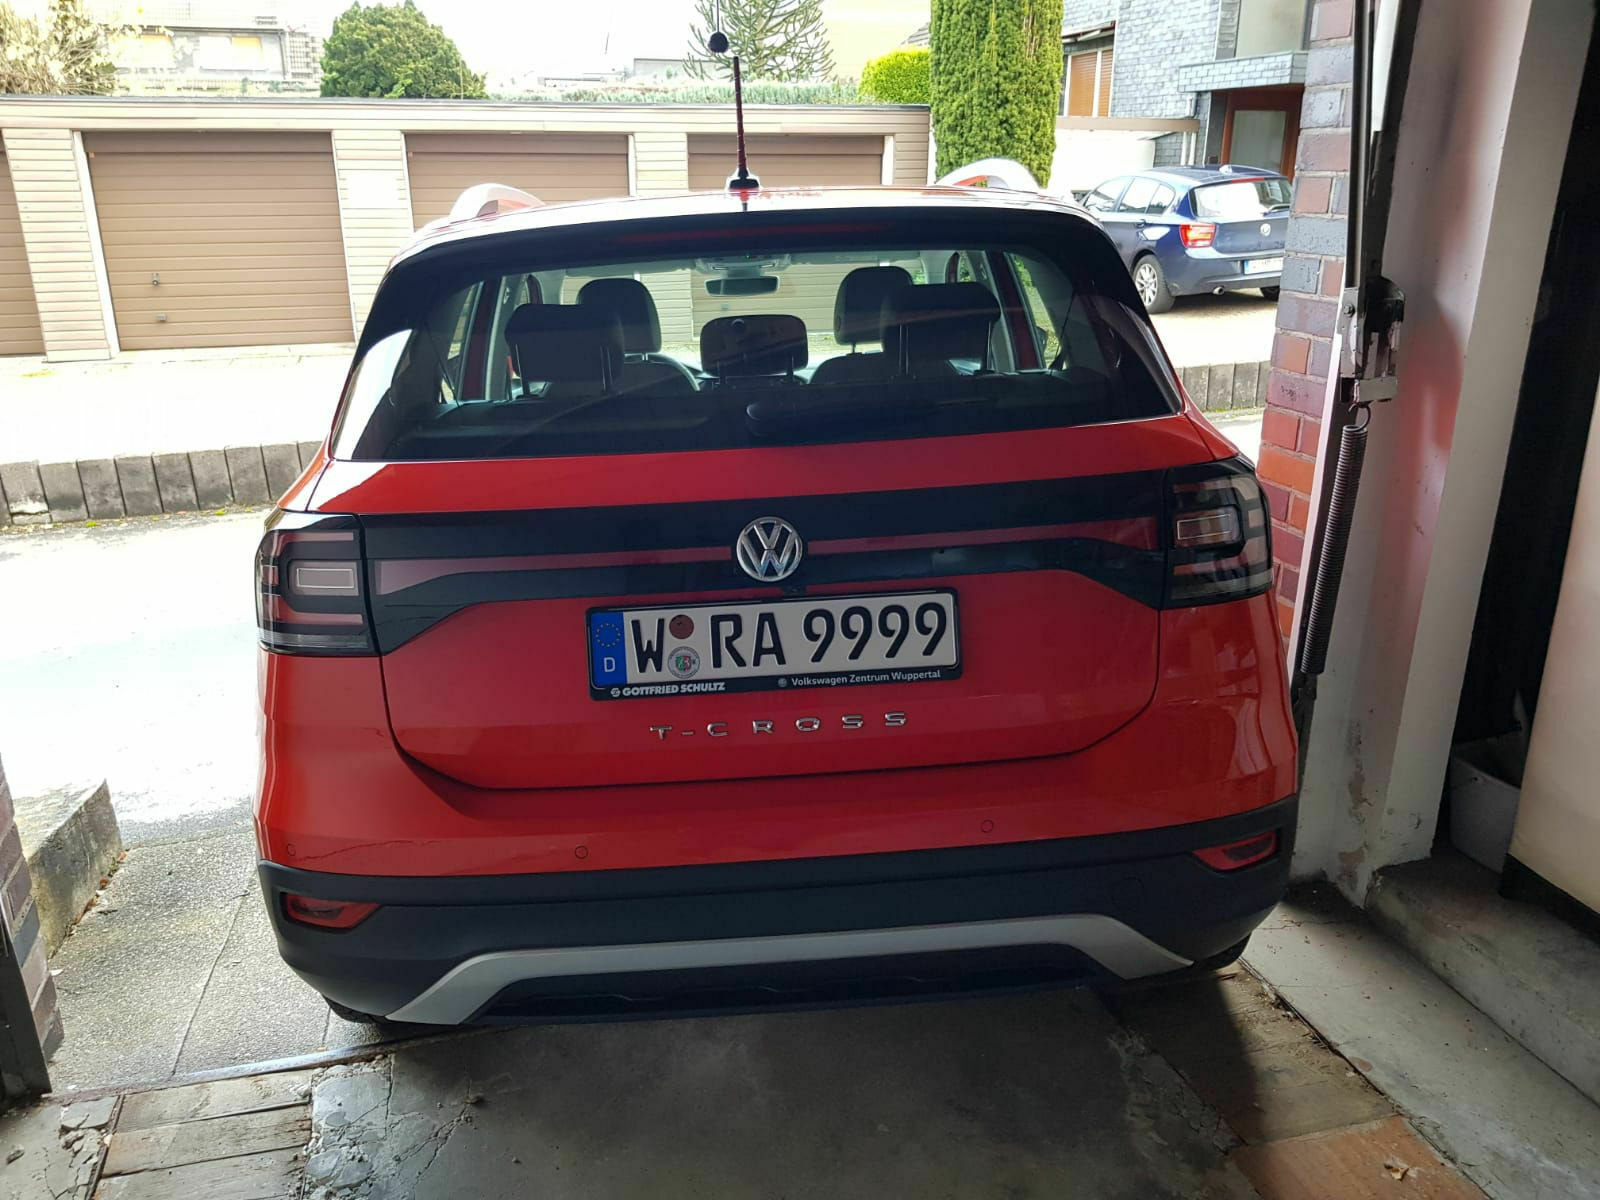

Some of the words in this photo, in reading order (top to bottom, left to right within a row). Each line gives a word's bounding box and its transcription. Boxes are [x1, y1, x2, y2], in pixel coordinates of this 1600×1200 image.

[737, 516, 803, 582] VW
[631, 617, 665, 673] W
[710, 612, 787, 668] RA
[803, 602, 946, 663] 9999
[603, 657, 616, 673] D
[791, 676, 848, 687] Volkswagen
[850, 673, 890, 683] Zentrum
[891, 669, 941, 681] Wuppertal
[622, 684, 680, 697] GOTTFRIED
[680, 681, 726, 694] SCHULTZ
